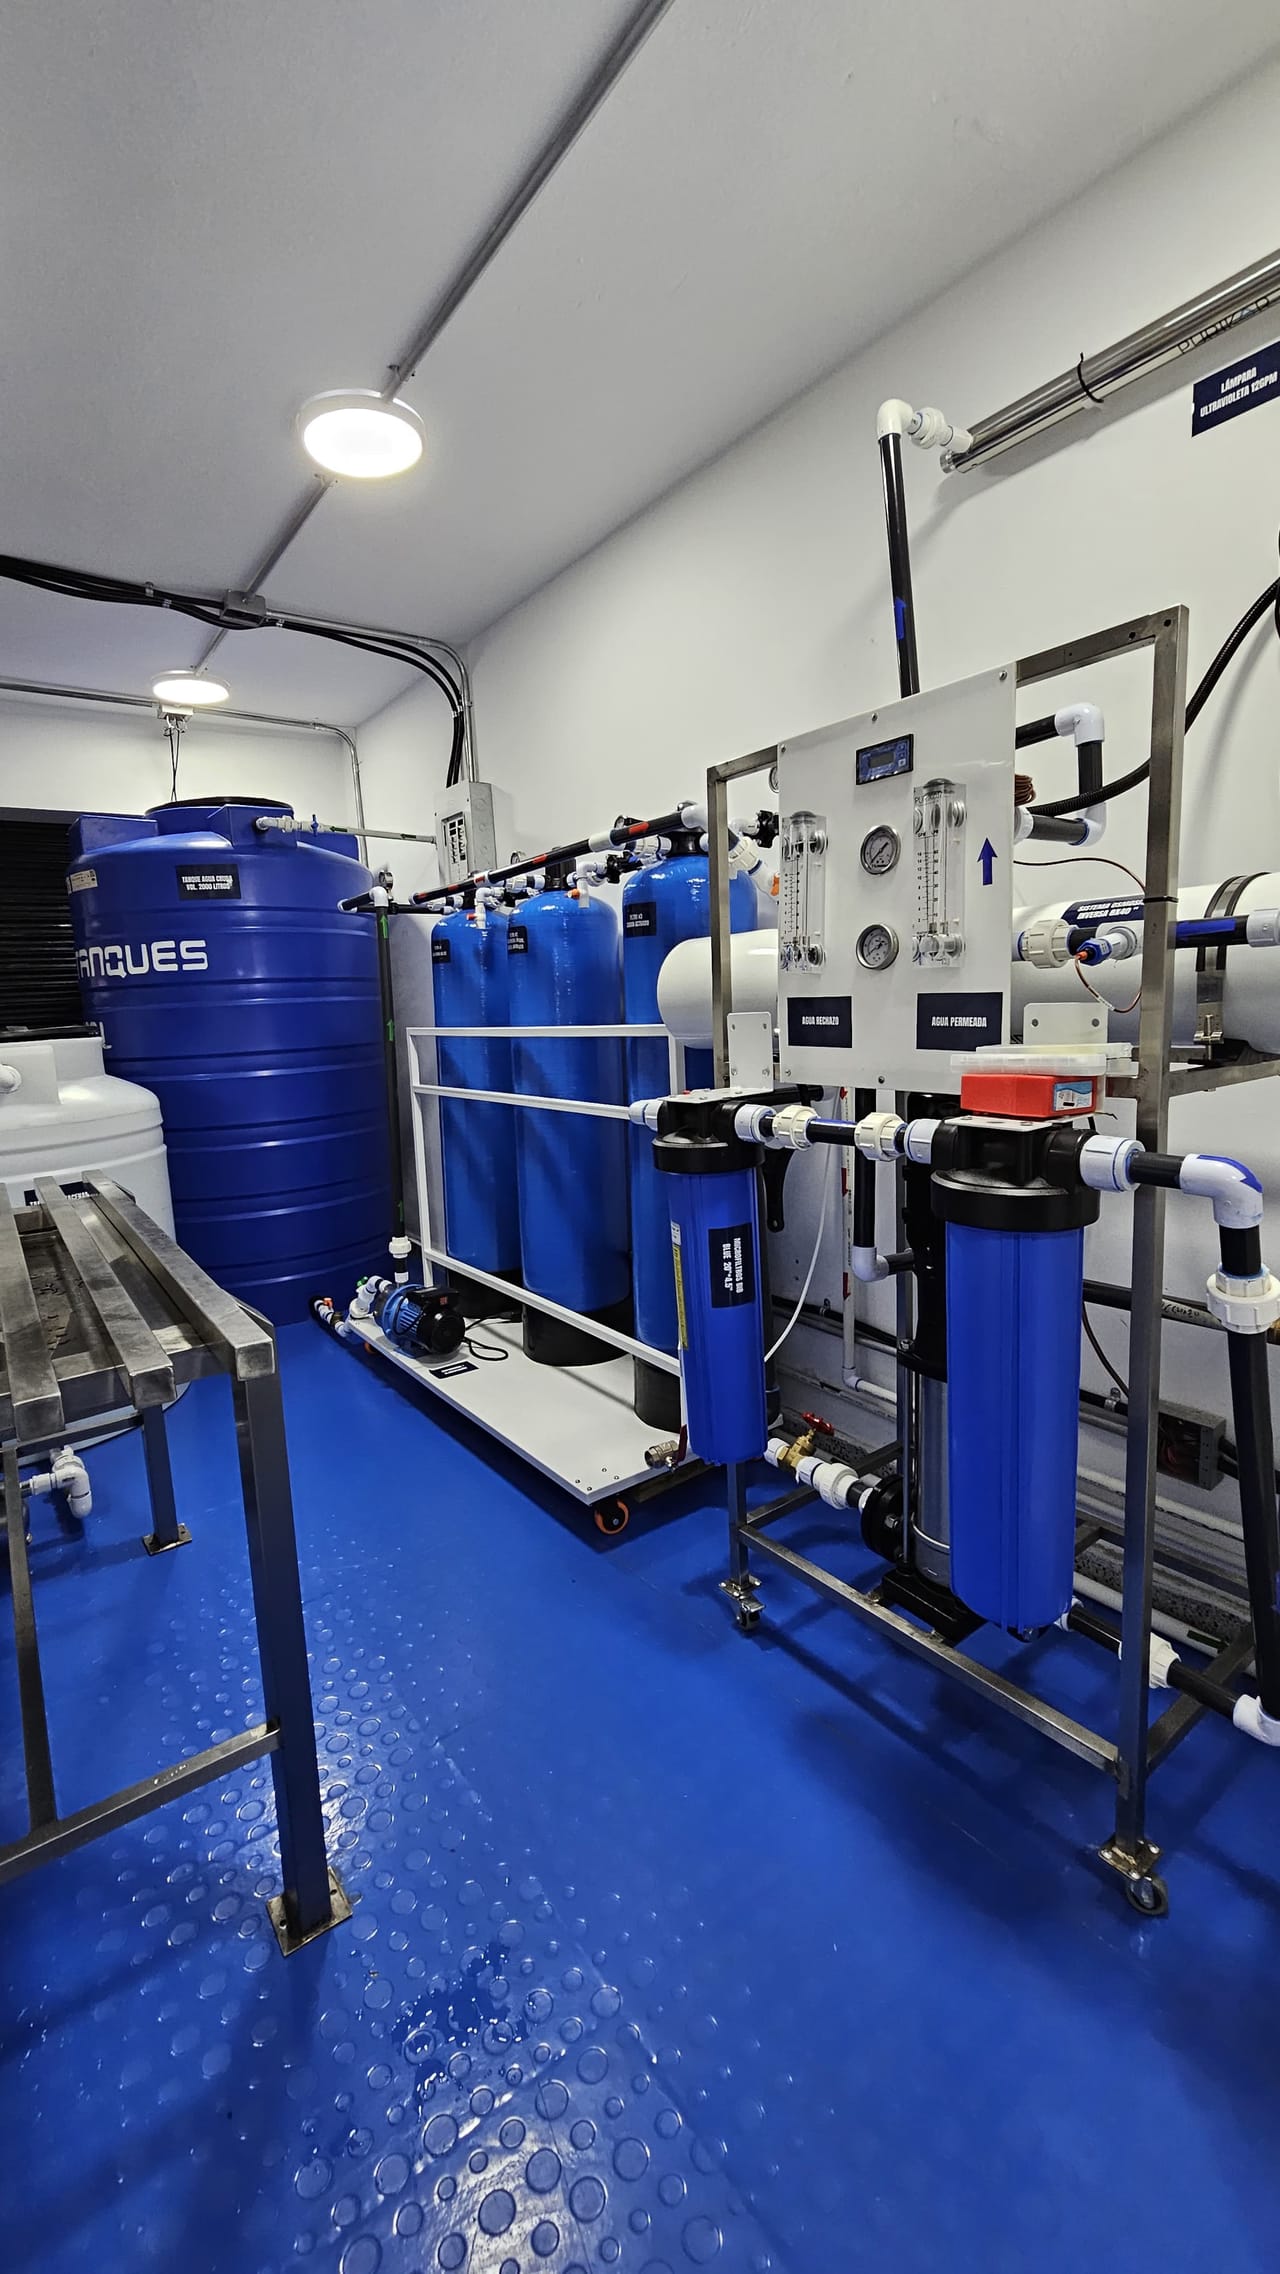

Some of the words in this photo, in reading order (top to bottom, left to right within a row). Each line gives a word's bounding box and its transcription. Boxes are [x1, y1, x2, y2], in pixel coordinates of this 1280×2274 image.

[1221, 366, 1257, 394] LÁMPARA
[1200, 384, 1250, 418] ULTRAVIOLETA
[1250, 371, 1278, 393] 12GPM
[1076, 909, 1110, 920] INVERSA
[1077, 902, 1111, 913] SISTEMA
[802, 1016, 816, 1026] AGUA
[816, 1016, 840, 1026] RECHAZO
[931, 1016, 949, 1027] AGUA
[950, 1016, 988, 1028] PERMEADA
[722, 1243, 732, 1260] BLUE
[733, 1237, 743, 1281] MICROFILTROS
